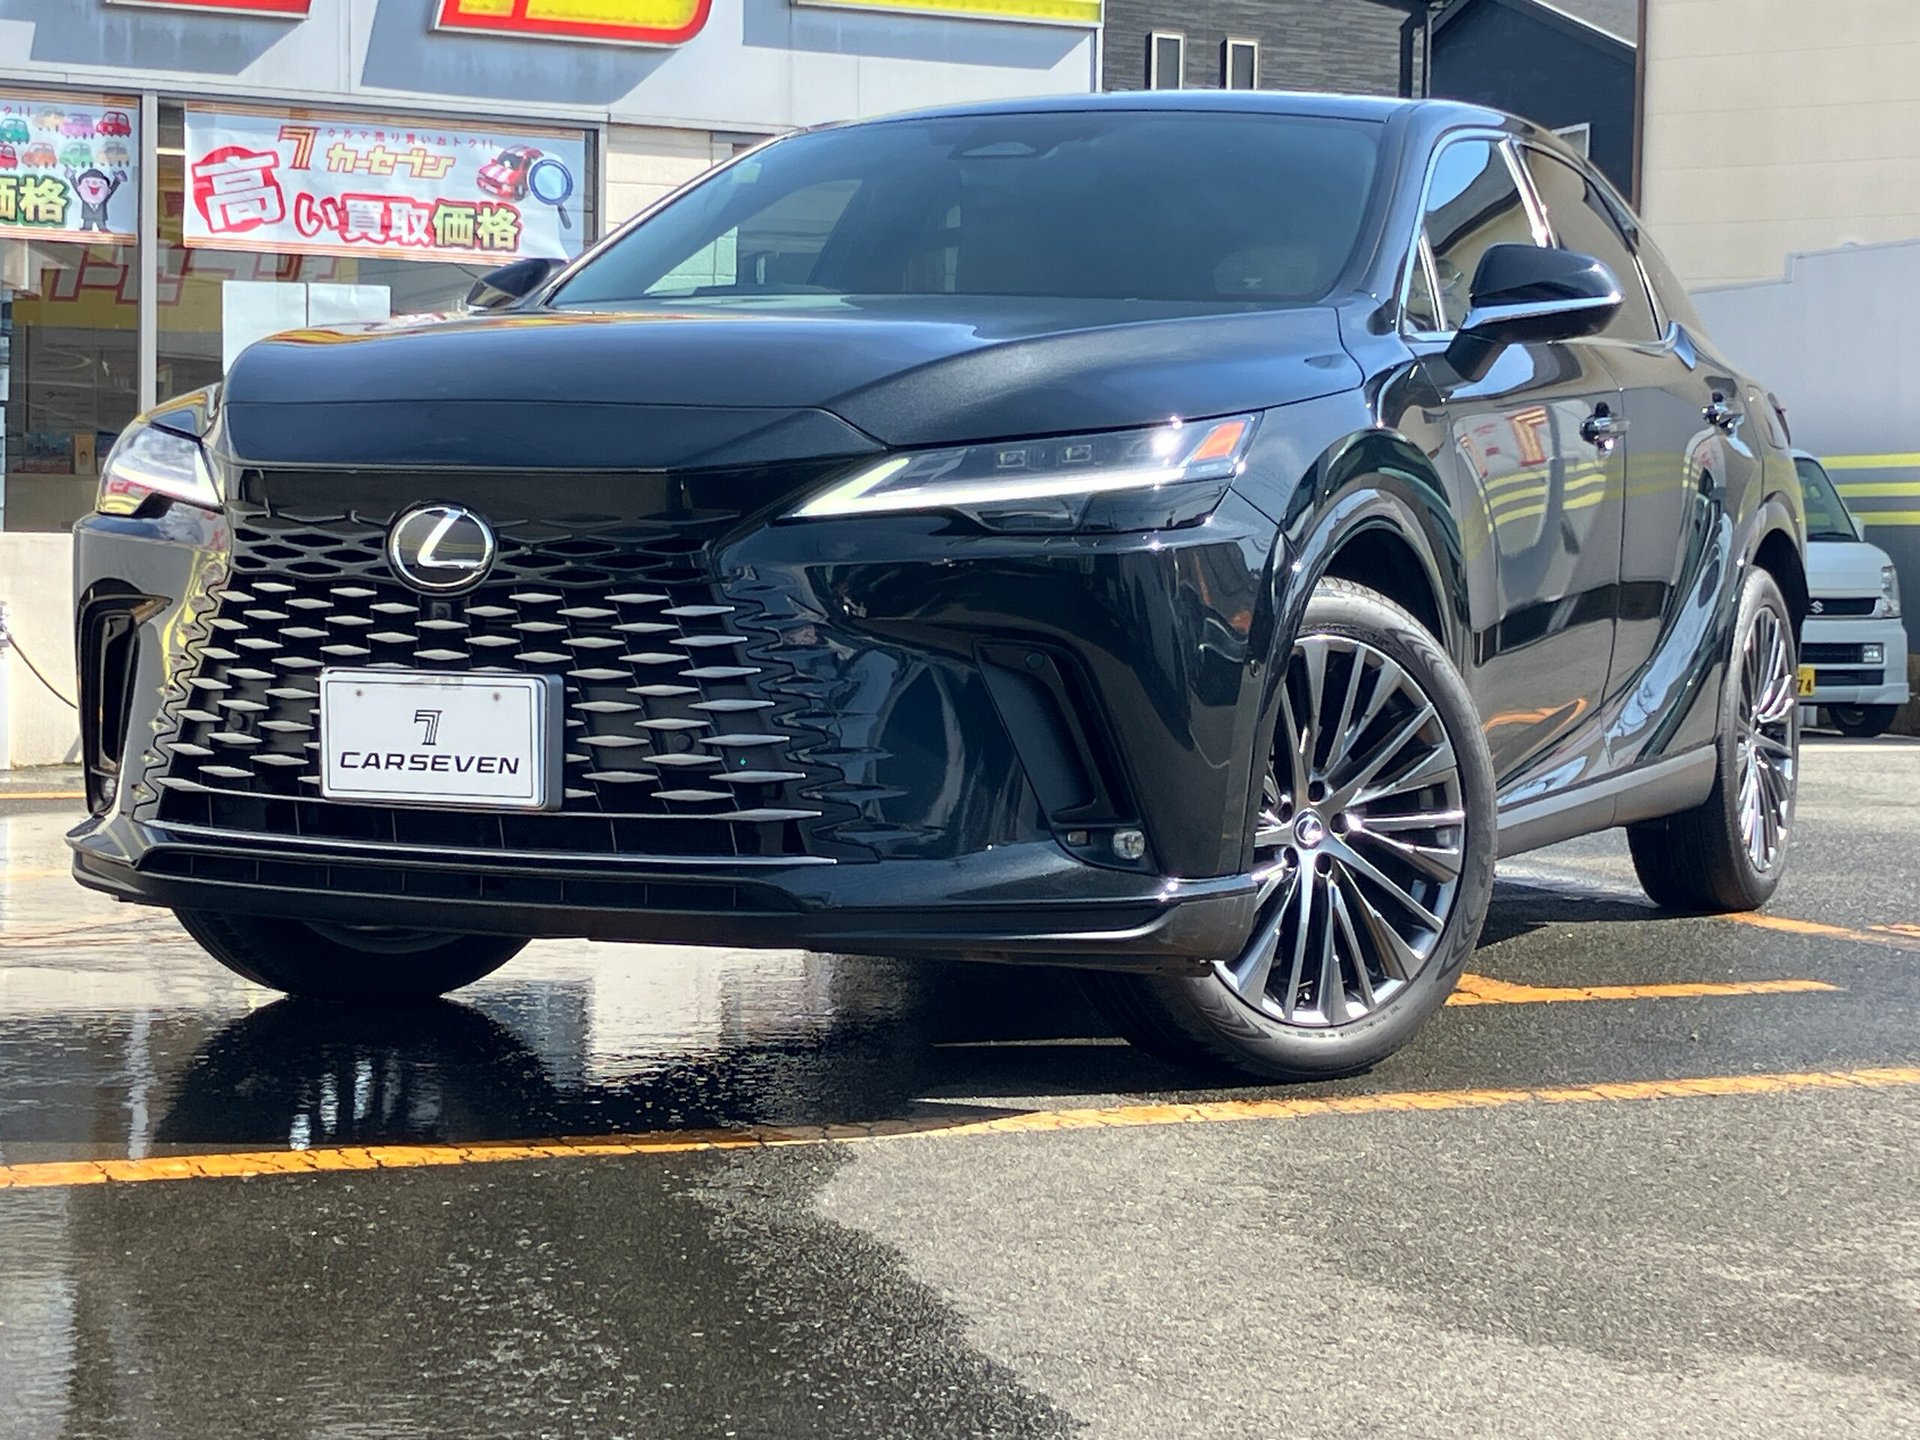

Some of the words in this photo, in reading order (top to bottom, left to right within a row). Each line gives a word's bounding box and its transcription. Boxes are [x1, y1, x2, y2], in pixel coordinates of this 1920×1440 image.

[327, 142, 456, 179] カーセブン
[340, 751, 520, 775] CARSEVEN
